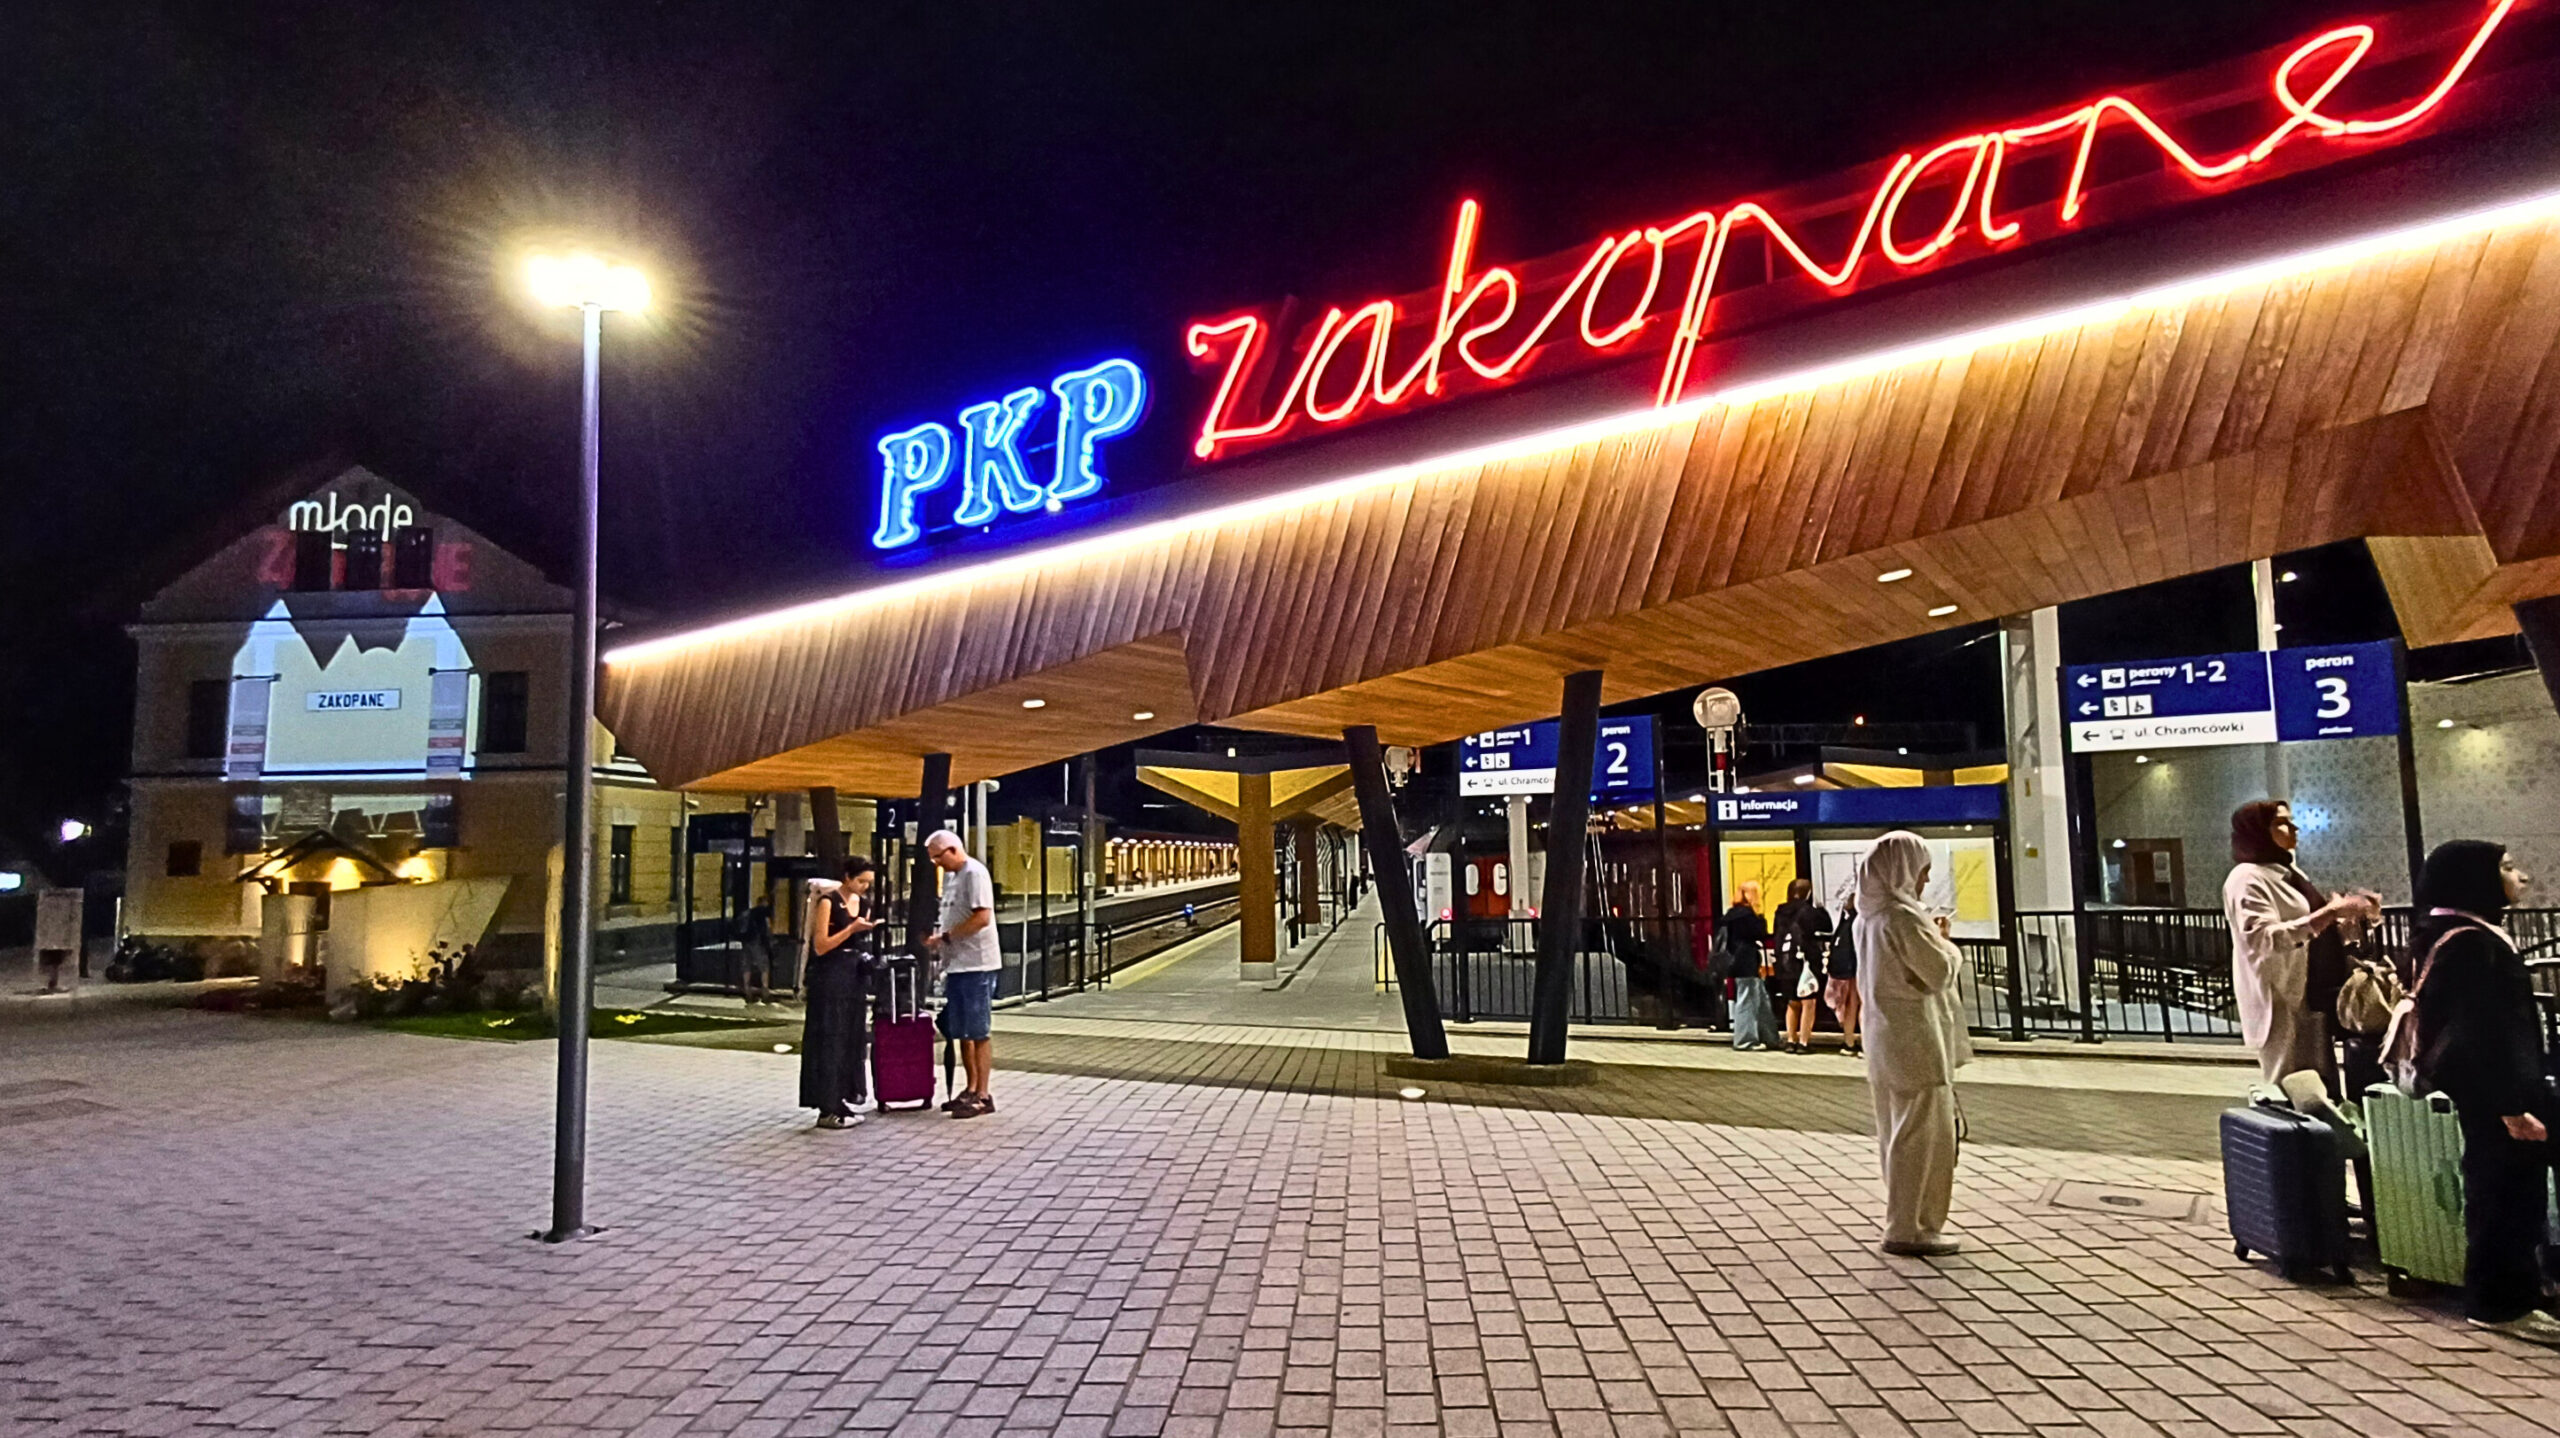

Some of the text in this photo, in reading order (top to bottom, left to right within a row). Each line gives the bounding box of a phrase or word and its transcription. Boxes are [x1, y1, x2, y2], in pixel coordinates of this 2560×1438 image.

[872, 358, 1146, 548] PKP
[2129, 665, 2177, 680] perony
[2181, 660, 2227, 684] 1-2
[2305, 655, 2354, 671] peron
[318, 693, 385, 708] ZAKOPANE
[2315, 677, 2351, 718] 3
[1522, 728, 1531, 746] 1
[1602, 726, 1631, 738] peron
[1607, 742, 1629, 774] 2
[887, 808, 896, 828] 2
